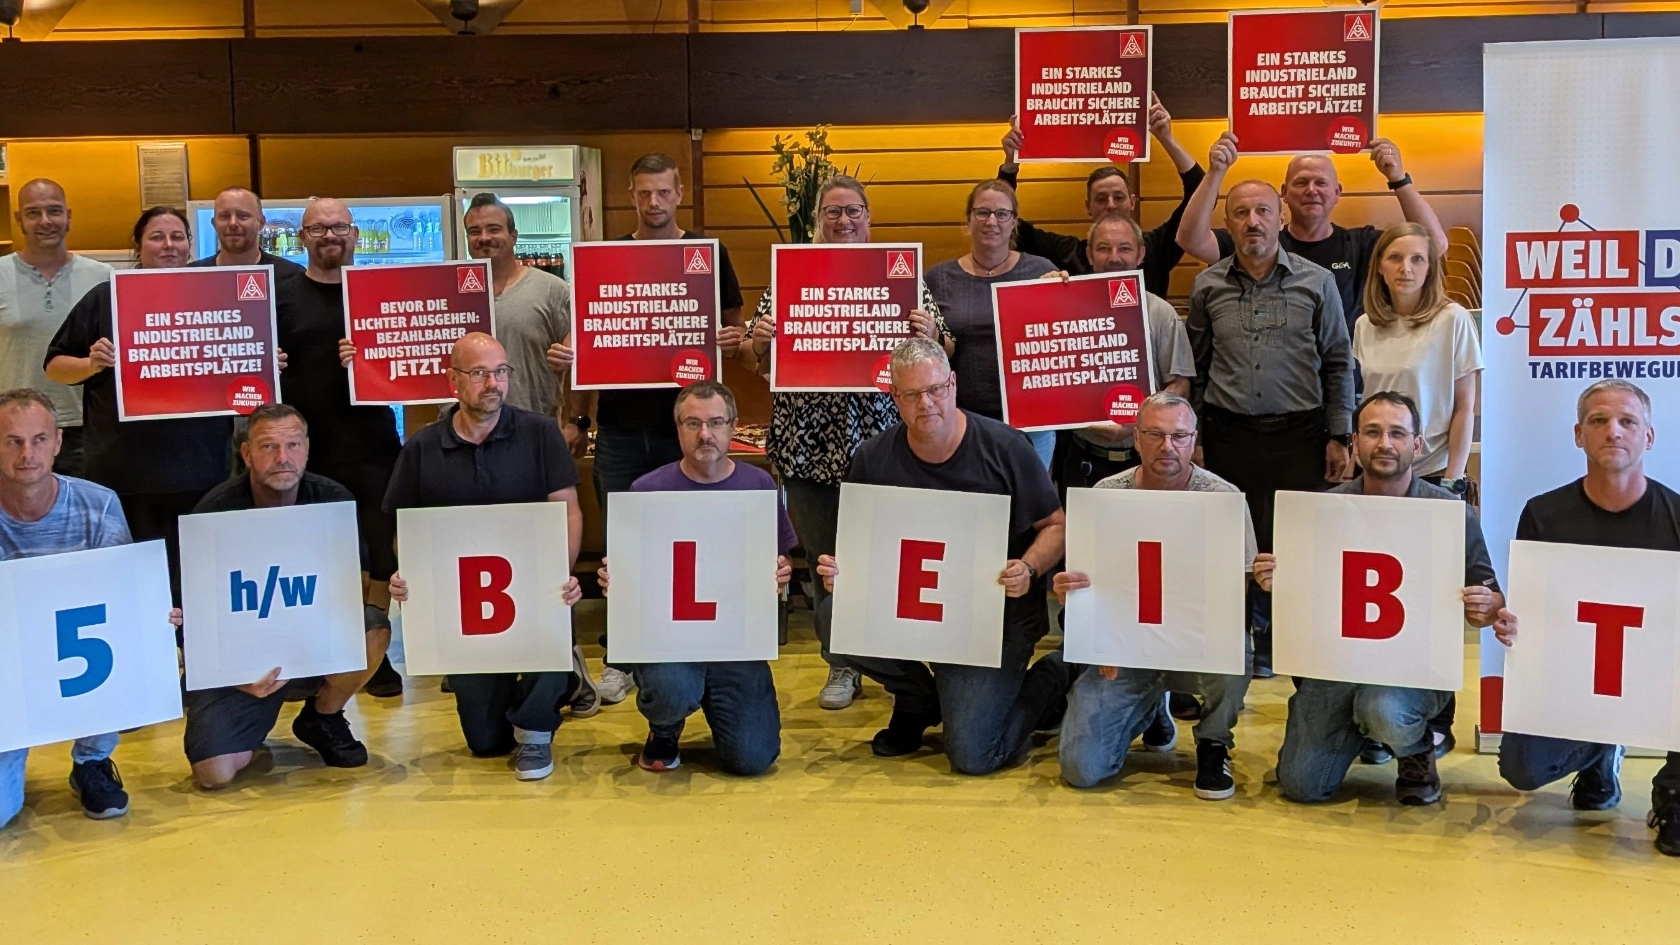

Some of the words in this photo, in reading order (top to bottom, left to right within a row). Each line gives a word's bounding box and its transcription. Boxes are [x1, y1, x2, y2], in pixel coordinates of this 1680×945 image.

[1257, 53, 1280, 66] EIN
[1284, 50, 1346, 65] STARKES
[1042, 67, 1062, 79] EIN
[1066, 66, 1122, 79] STARKES
[1246, 67, 1357, 83] INDUSTRIELAND
[1032, 82, 1132, 95] INDUSTRIELAND
[1240, 85, 1305, 99] BRAUCHT
[1308, 83, 1366, 97] SICHERE
[1027, 98, 1085, 110] BRAUCHT
[1088, 97, 1140, 110] SICHERE
[1249, 98, 1362, 116] ARBEITSPLÄTZE!
[1034, 110, 1137, 125] ARBEITSPLÄTZE!
[1110, 142, 1134, 150] MACHEN
[1331, 139, 1361, 148] ZUKUNFT!
[1515, 240, 1629, 280] WEIL
[1654, 239, 1680, 278] D
[599, 285, 622, 298] EIN
[626, 283, 687, 297] STARKES
[801, 287, 824, 300] EIN
[827, 287, 890, 300] STARKES
[381, 301, 424, 314] BEVOR
[427, 299, 448, 310] DIE
[589, 299, 699, 315] INDUSTRIELAND
[789, 304, 901, 317] INDUSTRIELAND
[145, 313, 171, 327] EIN
[174, 309, 242, 326] STARKES
[354, 317, 406, 331] LICHTER
[410, 312, 480, 327] AUSGEHEN:
[584, 317, 648, 331] BRAUCHT
[651, 315, 708, 330] SICHERE
[1538, 297, 1680, 347] ZÄHLS
[784, 321, 849, 334] BRAUCHT
[852, 320, 910, 334] SICHERE
[1025, 323, 1049, 338] EIN
[1052, 317, 1115, 335] STARKES
[133, 326, 254, 345] INDUSTRIELAND
[377, 328, 466, 344] BEZAHLBARER
[593, 330, 706, 348] ARBEITSPLÄTZE!
[128, 346, 199, 362] BRAUCHT
[203, 342, 265, 358] SICHERE
[364, 343, 455, 360] INDUSTRIESTR
[1015, 333, 1128, 356] INDUSTRIELAND
[140, 358, 262, 379] ARBEITSPLÄTZE!
[678, 365, 704, 373] MACHEN
[1011, 355, 1076, 373] BRAUCHT
[1081, 349, 1140, 367] SICHERE
[389, 358, 446, 381] JETZT.
[1529, 361, 1680, 379] TARIFBEWEGU
[1022, 366, 1137, 390] ARBEITSPLÄTZE!
[229, 565, 318, 619] h/w
[54, 602, 114, 699] 5
